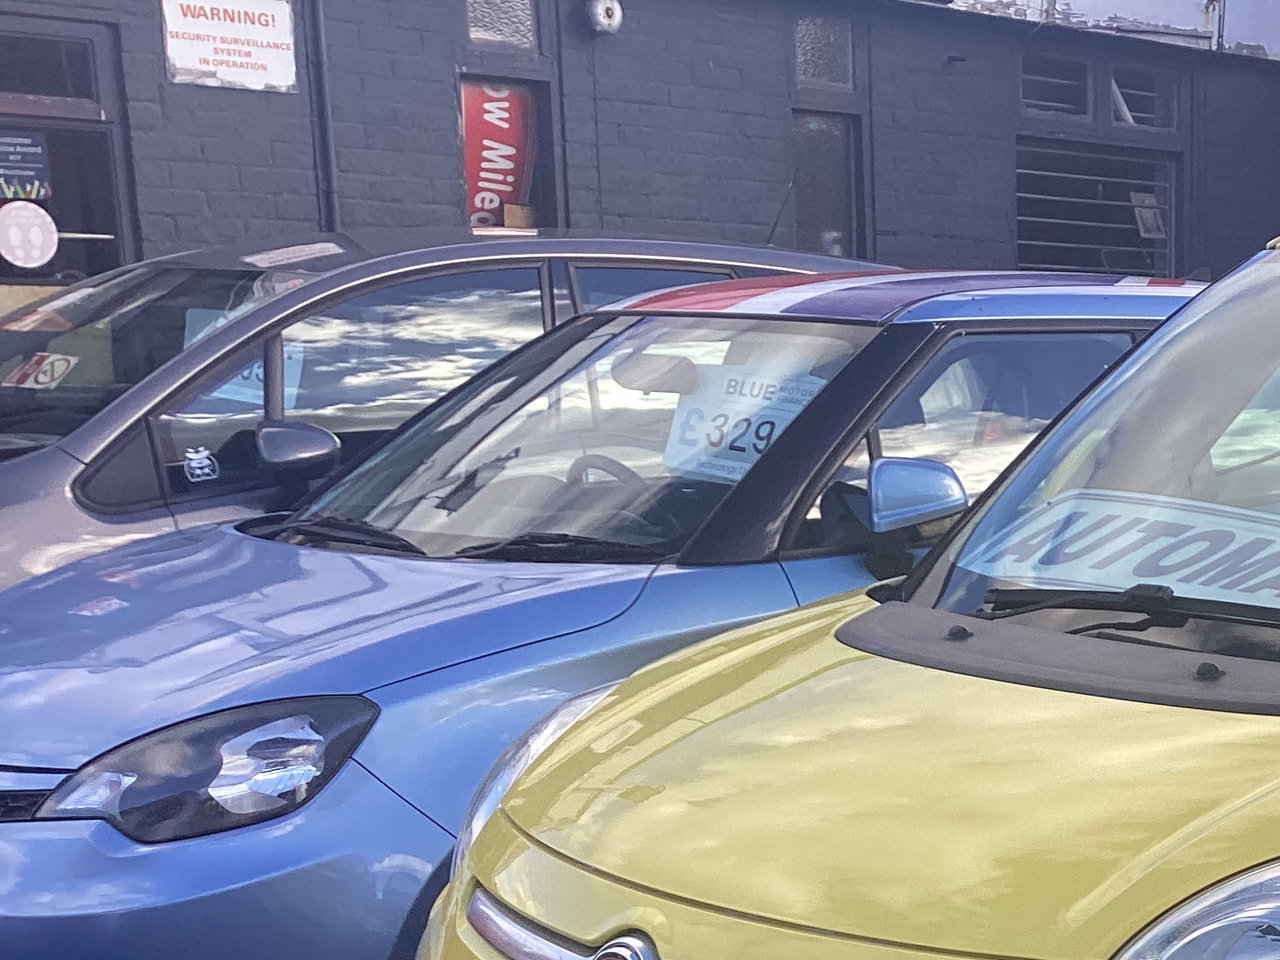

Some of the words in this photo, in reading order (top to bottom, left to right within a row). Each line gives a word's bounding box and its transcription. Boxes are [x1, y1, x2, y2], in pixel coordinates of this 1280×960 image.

[180, 3, 276, 28] WARNING!
[169, 31, 217, 43] SECURITY
[220, 36, 292, 51] SURVEILLANCE
[213, 47, 252, 58] SYSTEM
[199, 57, 210, 66] IN
[212, 59, 268, 71] OPERATION
[725, 378, 777, 401] BLUE
